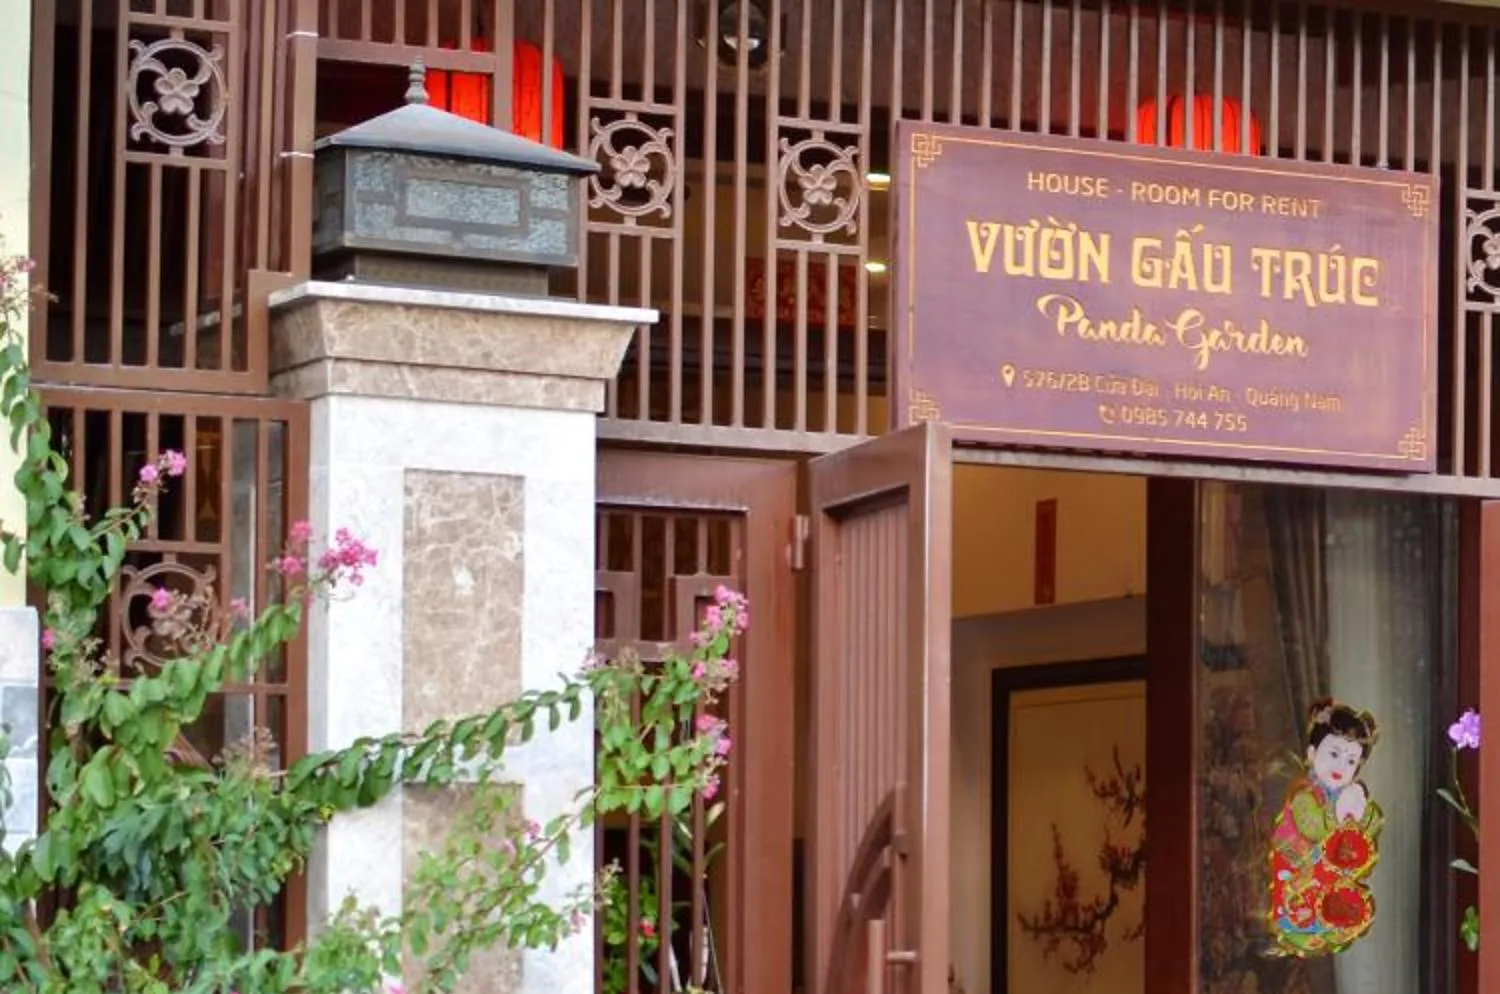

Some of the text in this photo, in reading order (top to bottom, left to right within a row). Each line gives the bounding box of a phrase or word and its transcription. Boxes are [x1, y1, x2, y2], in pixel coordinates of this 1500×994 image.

[1027, 172, 1109, 198] HOUSE
[1131, 181, 1200, 208] ROOM
[1207, 188, 1255, 212] FOR
[1261, 195, 1323, 218] RENT
[966, 215, 1380, 307] VƯỜN GẤU TRÚC
[1036, 293, 1310, 372] Panda Garden
[1121, 404, 1248, 433] 0985 744 755
